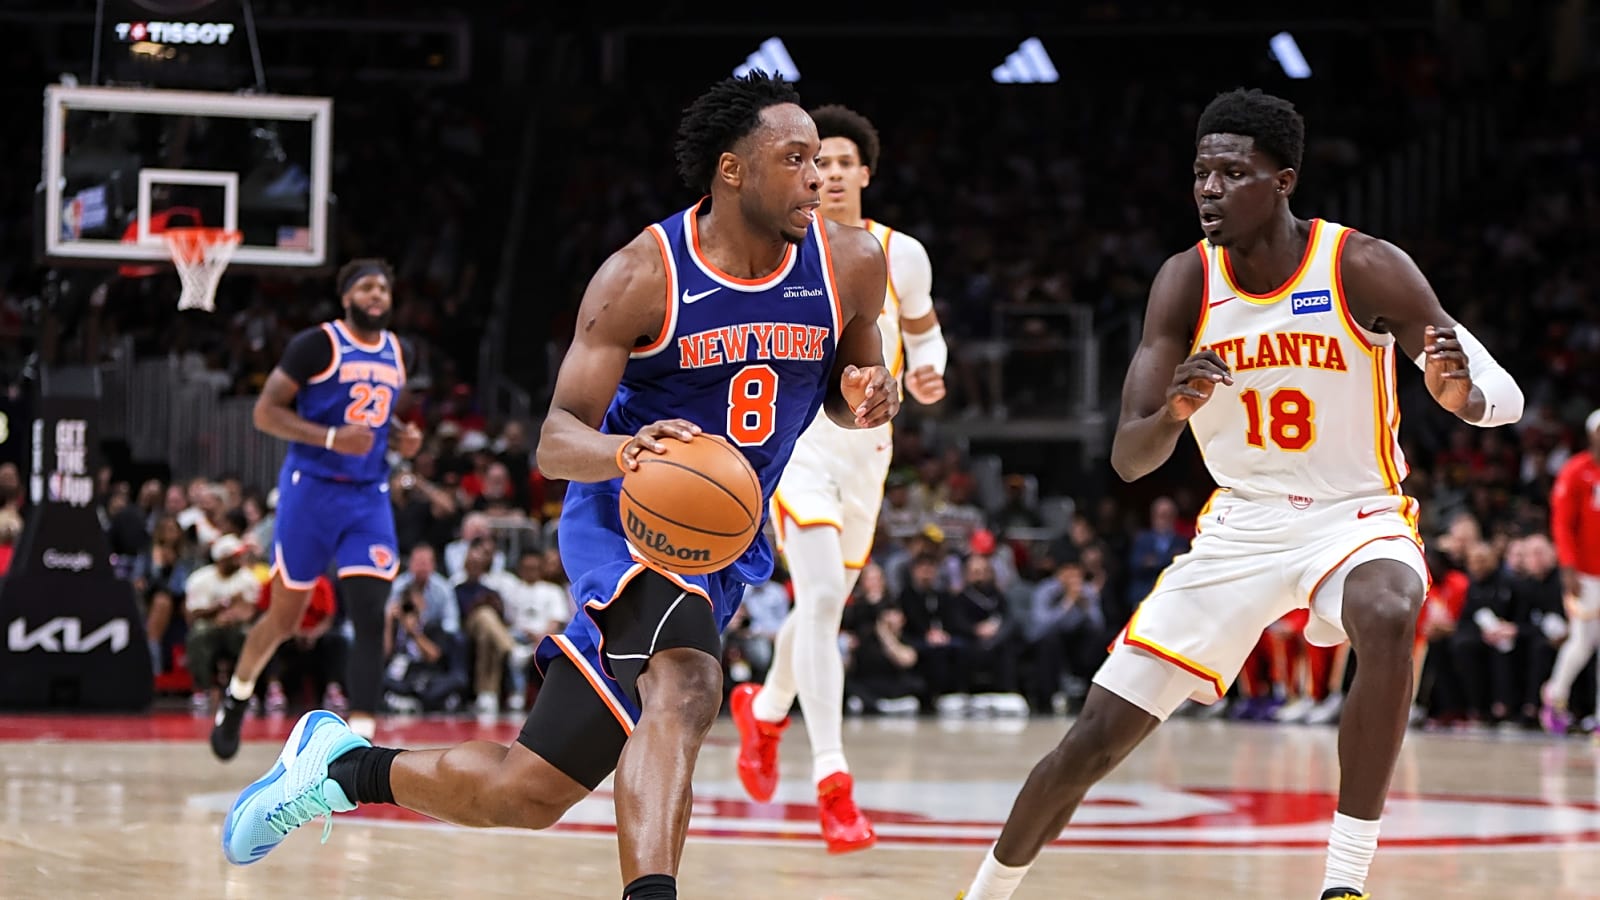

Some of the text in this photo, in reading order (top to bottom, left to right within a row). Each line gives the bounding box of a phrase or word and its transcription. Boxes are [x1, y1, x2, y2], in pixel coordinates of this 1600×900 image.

[147, 22, 234, 44] TISSOT
[783, 288, 823, 298] abu dhabi
[1293, 295, 1329, 310] paze
[678, 322, 830, 368] NEW YORK
[344, 382, 393, 428] 23
[726, 364, 779, 447] 8
[1239, 387, 1318, 453] 18
[626, 507, 711, 561] Wilson
